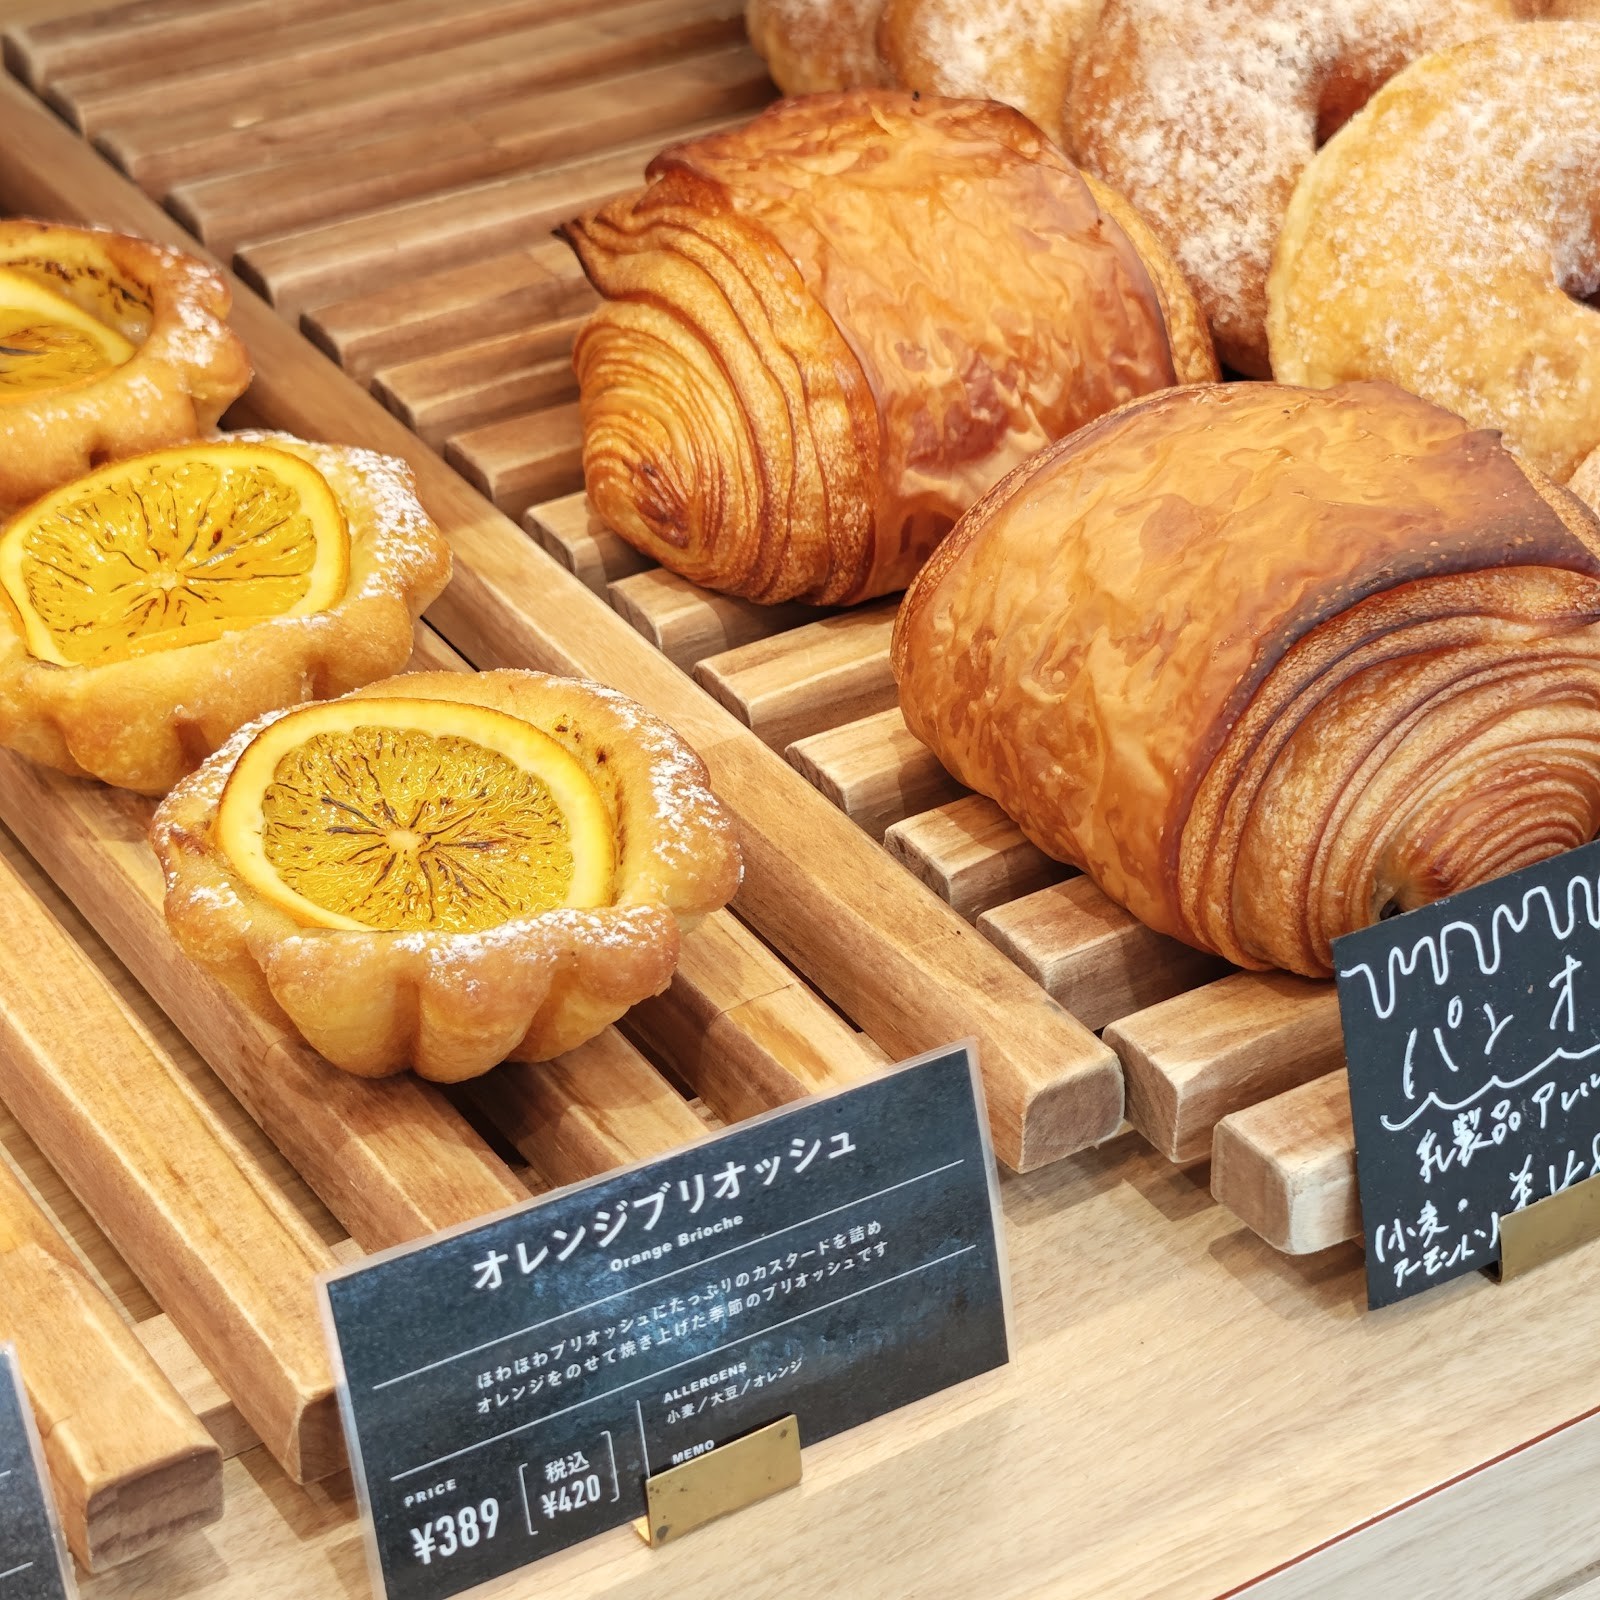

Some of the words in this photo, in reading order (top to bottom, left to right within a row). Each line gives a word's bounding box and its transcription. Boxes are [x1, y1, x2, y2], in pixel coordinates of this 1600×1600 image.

[472, 1131, 857, 1290] オレンジブリオッシュ
[610, 1241, 673, 1272] Orange
[678, 1213, 744, 1247] Brioche
[477, 1220, 882, 1389] ほわほわブリオッシュにたっぷりのカスタードを詰め
[477, 1240, 888, 1414] オレンジをのせて焼き上げた季節のブリオッシュです
[663, 1361, 747, 1404] ALLERGENS
[544, 1450, 591, 1484] 税込
[671, 1439, 715, 1465] MEMO
[402, 1478, 457, 1508] PRICE
[541, 1473, 601, 1520] ¥420
[409, 1497, 500, 1566] ¥389
